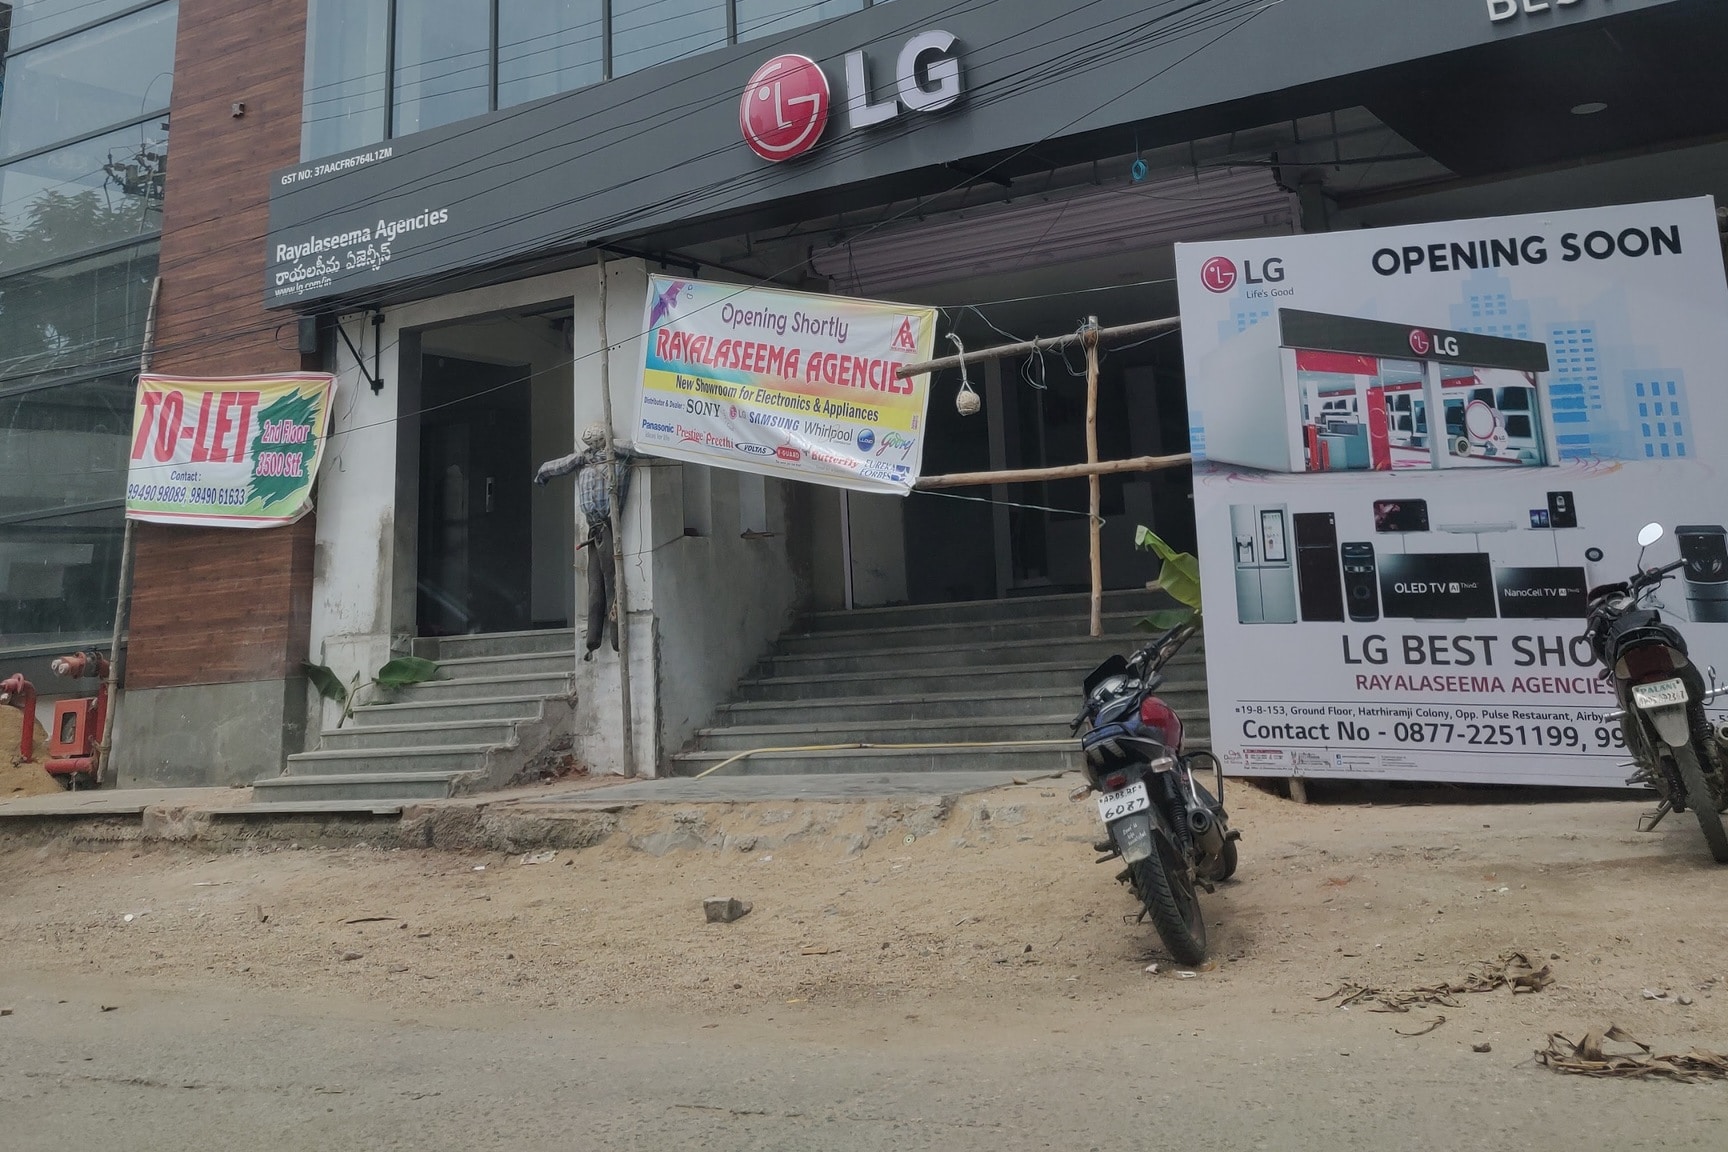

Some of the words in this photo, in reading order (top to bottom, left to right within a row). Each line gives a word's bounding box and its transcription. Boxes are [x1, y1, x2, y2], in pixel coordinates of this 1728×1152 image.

[845, 29, 960, 129] LG
[281, 173, 297, 185] GST
[298, 169, 313, 181] NO:
[276, 228, 371, 264] Rayalaseema
[374, 208, 448, 241] Agencies
[1372, 235, 1548, 276] OPENING
[1560, 224, 1683, 262] SOON
[1244, 257, 1285, 285] LG
[274, 276, 332, 298] www.lg.com/in
[1246, 289, 1269, 299] Life's
[1271, 287, 1294, 297] Good
[721, 302, 787, 336] Opening
[791, 311, 849, 343] Shortly
[1433, 334, 1459, 357] LG
[655, 328, 800, 381] RAYALASEEMA
[806, 351, 914, 395] AGENCIES
[675, 374, 694, 389] New
[695, 377, 737, 398] Showroom
[739, 385, 753, 401] for
[754, 389, 811, 411] Electronics
[813, 398, 821, 412] &
[822, 399, 879, 422] Appliances
[686, 399, 720, 418] SONY
[132, 390, 260, 463] TO-LET
[642, 419, 674, 433] Panasonic
[749, 411, 799, 431] SAMSUNG
[804, 421, 853, 442] Whirlpool
[262, 420, 283, 443] 2nd
[281, 420, 310, 444] Floor
[676, 424, 704, 442] Prestige
[706, 433, 734, 449] Preethi
[744, 445, 767, 454] VOLTAS
[876, 431, 915, 460] Godrej
[256, 452, 284, 477] 3500
[811, 450, 859, 468] Butterfly
[864, 459, 896, 472] EUREKA
[171, 470, 198, 482] Contact
[859, 469, 892, 480] FORBES
[128, 484, 156, 500] 99490
[156, 485, 187, 504] 98089,
[188, 487, 217, 505] 98490
[218, 488, 246, 506] 61633
[1394, 582, 1427, 593] OLED
[1429, 582, 1446, 593] TV
[1504, 588, 1543, 597] NanoCell
[1544, 588, 1557, 596] TV
[1342, 634, 1388, 665] LG
[1402, 635, 1498, 666] BEST
[1512, 635, 1599, 667] SHO
[1355, 674, 1505, 693] RAYALASEEMA
[1511, 676, 1616, 695] AGENCIES
[1290, 706, 1325, 716] Ground
[1328, 707, 1355, 717] Floor,
[1358, 707, 1413, 719] Hatrhiramji
[1415, 708, 1452, 719] Colony,
[1455, 709, 1478, 721] Opp.
[1482, 710, 1509, 720] Pulse
[1512, 710, 1573, 723] Restaurant,
[1576, 711, 1604, 724] Airby
[1242, 719, 1330, 741] Contact
[1337, 721, 1370, 741] No
[1394, 722, 1587, 752] 0877-2251199,
[1594, 727, 1626, 749] 99
[1105, 798, 1144, 819] 6087
